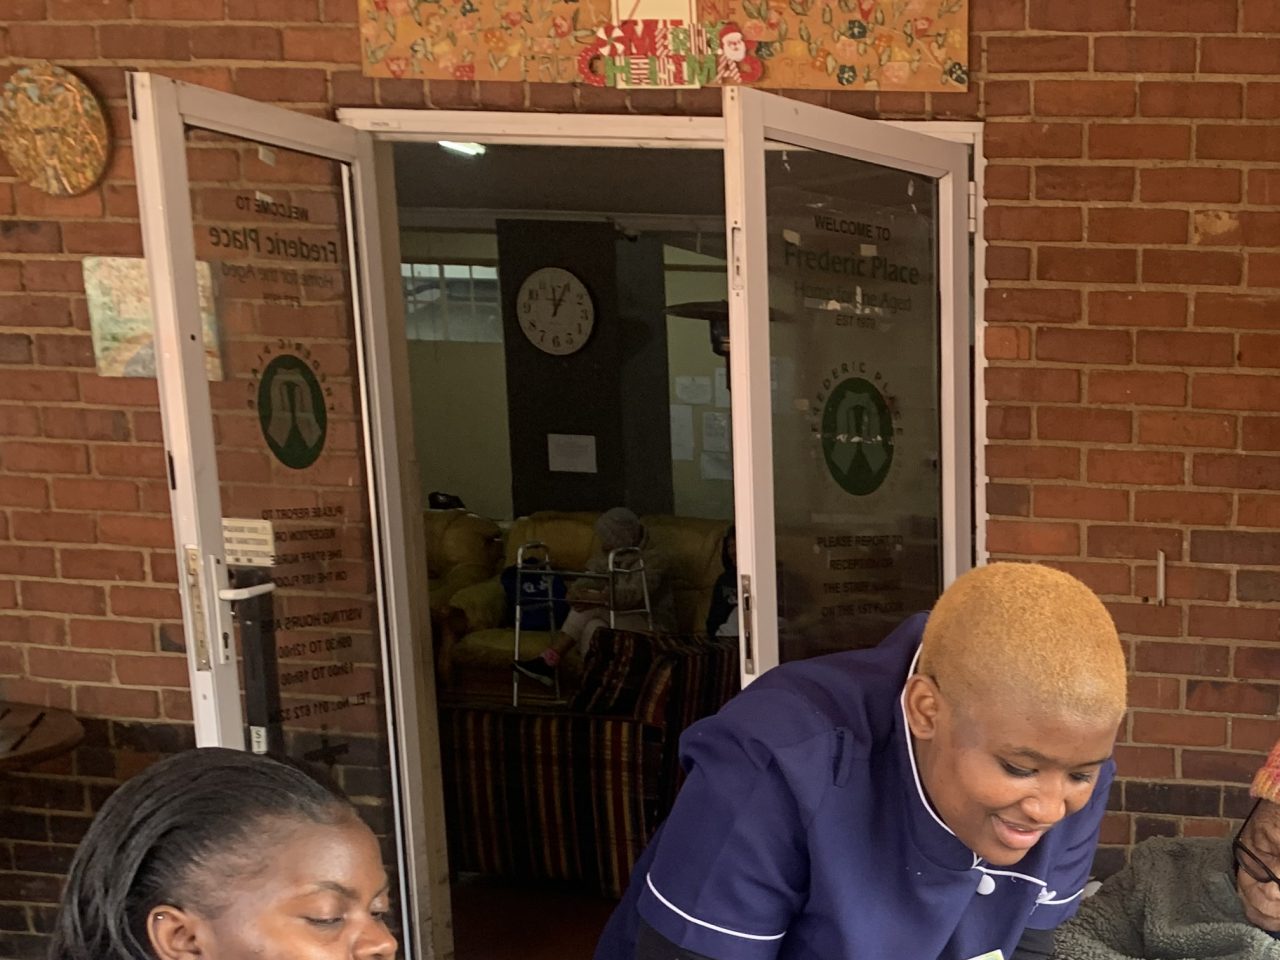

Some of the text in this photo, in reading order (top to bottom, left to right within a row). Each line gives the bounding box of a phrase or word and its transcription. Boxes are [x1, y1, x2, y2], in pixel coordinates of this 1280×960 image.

[814, 215, 890, 241] WELCOME TO
[784, 243, 919, 285] Frederic Place
[835, 314, 853, 327] EST
[817, 536, 853, 547] PLEASE
